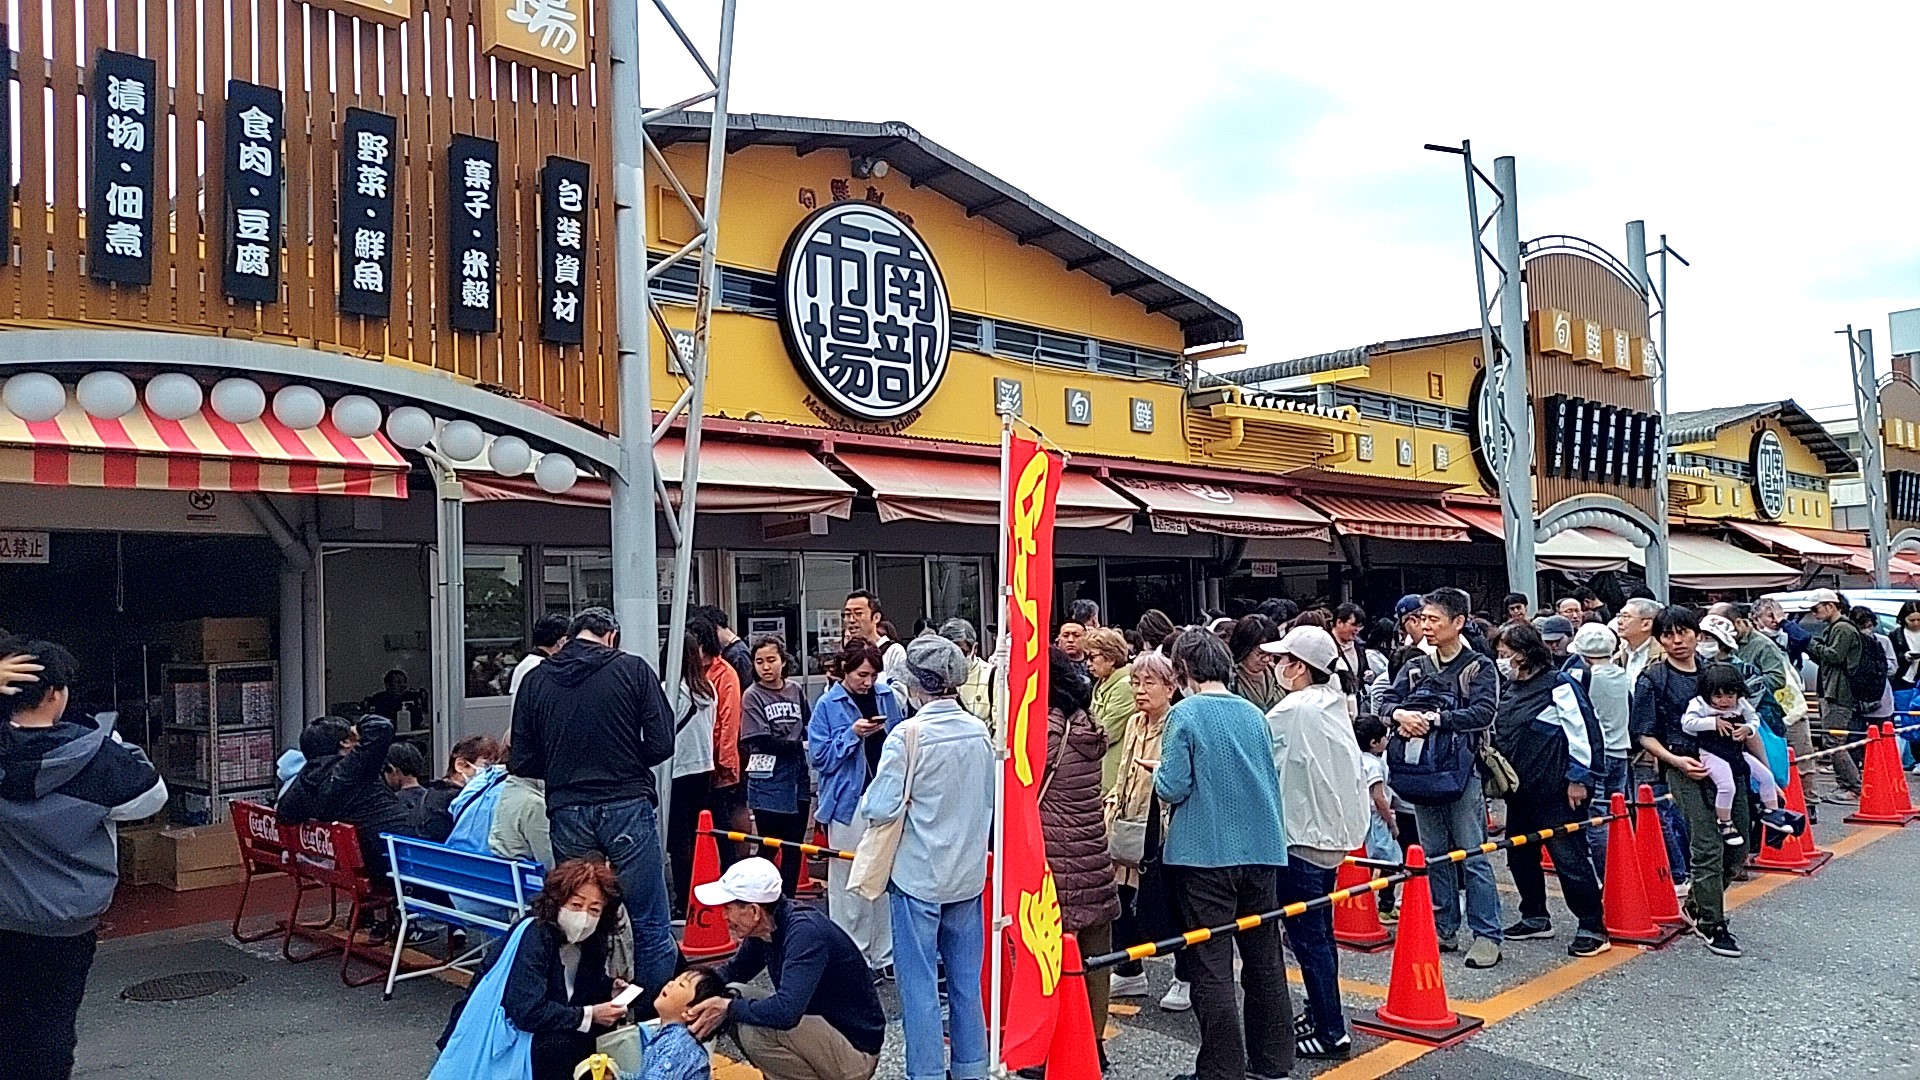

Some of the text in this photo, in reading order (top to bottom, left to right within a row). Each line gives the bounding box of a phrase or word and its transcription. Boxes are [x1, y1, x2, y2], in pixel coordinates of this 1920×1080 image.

[106, 75, 145, 258] 漬物・佃煮
[236, 105, 274, 277] 食肉・豆腐
[353, 131, 389, 293] 野菜・鮮魚
[462, 158, 492, 309] 菓子・米穀
[552, 179, 583, 322] 包装資材
[1071, 391, 1089, 421] 旬
